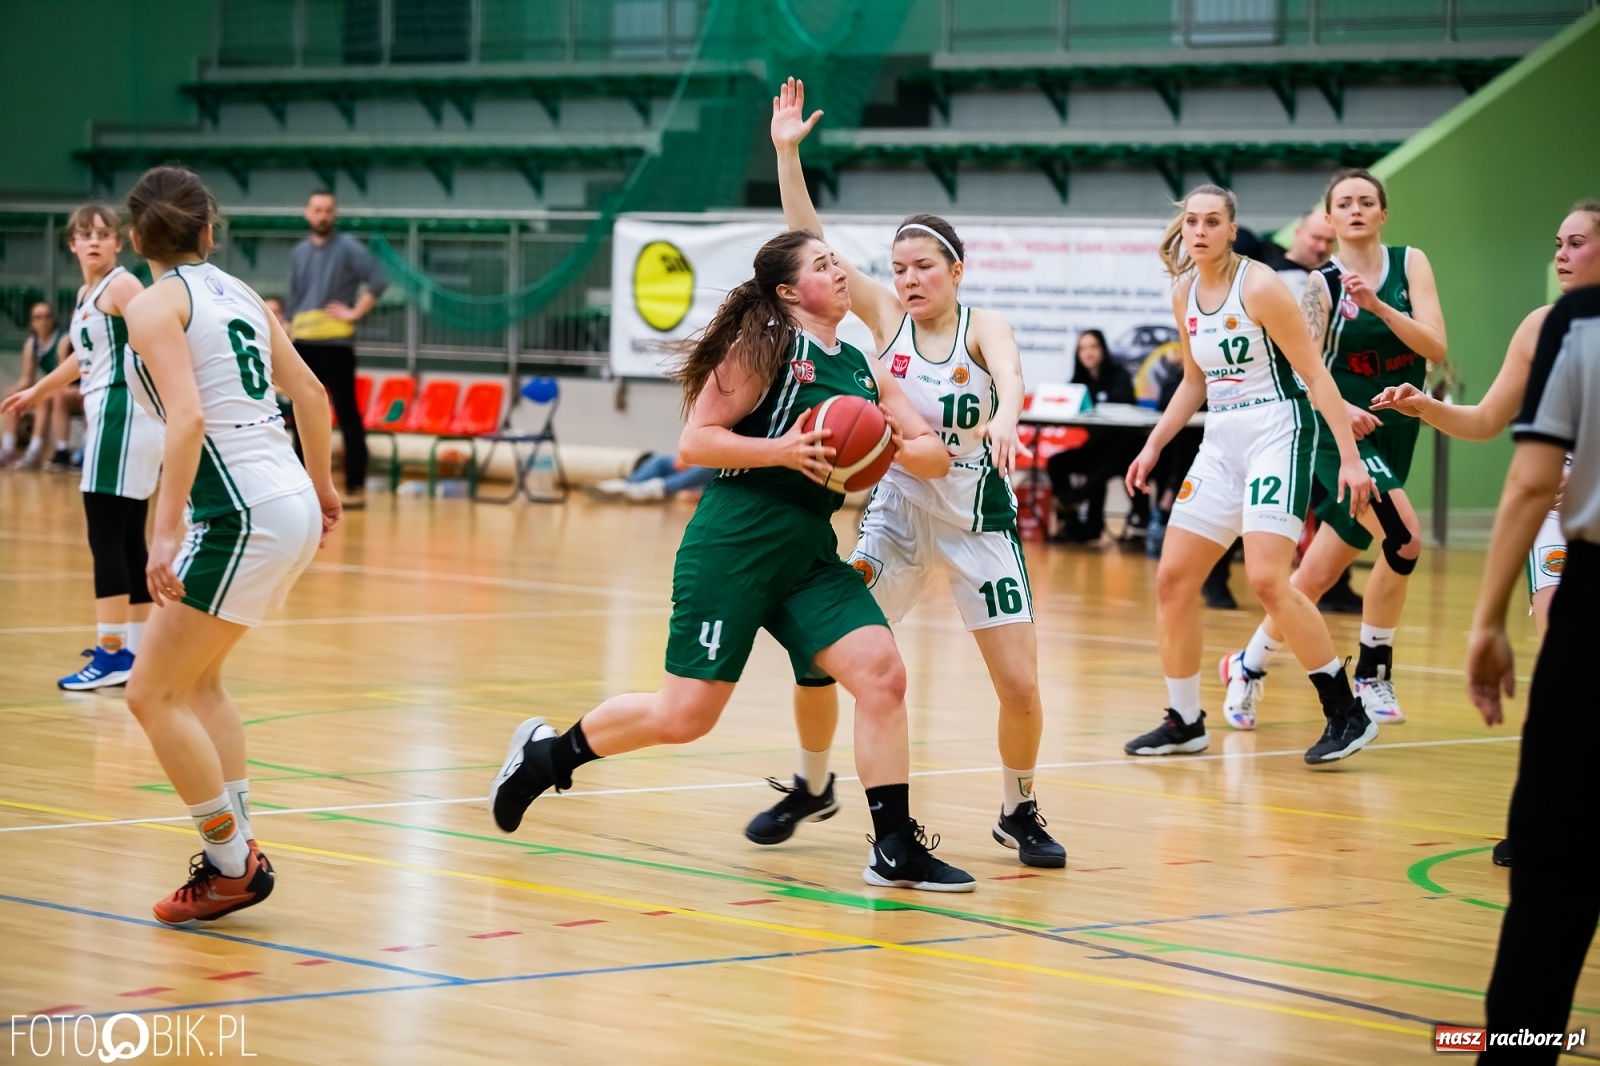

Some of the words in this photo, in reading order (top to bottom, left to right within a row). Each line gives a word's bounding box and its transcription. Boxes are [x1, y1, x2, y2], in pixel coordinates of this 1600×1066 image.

[81, 327, 94, 351] 4
[1218, 336, 1254, 365] 12
[228, 318, 269, 400] 6
[938, 393, 980, 429] 16
[1249, 476, 1282, 506] 12
[979, 577, 1023, 618] 16
[699, 620, 723, 661] 4
